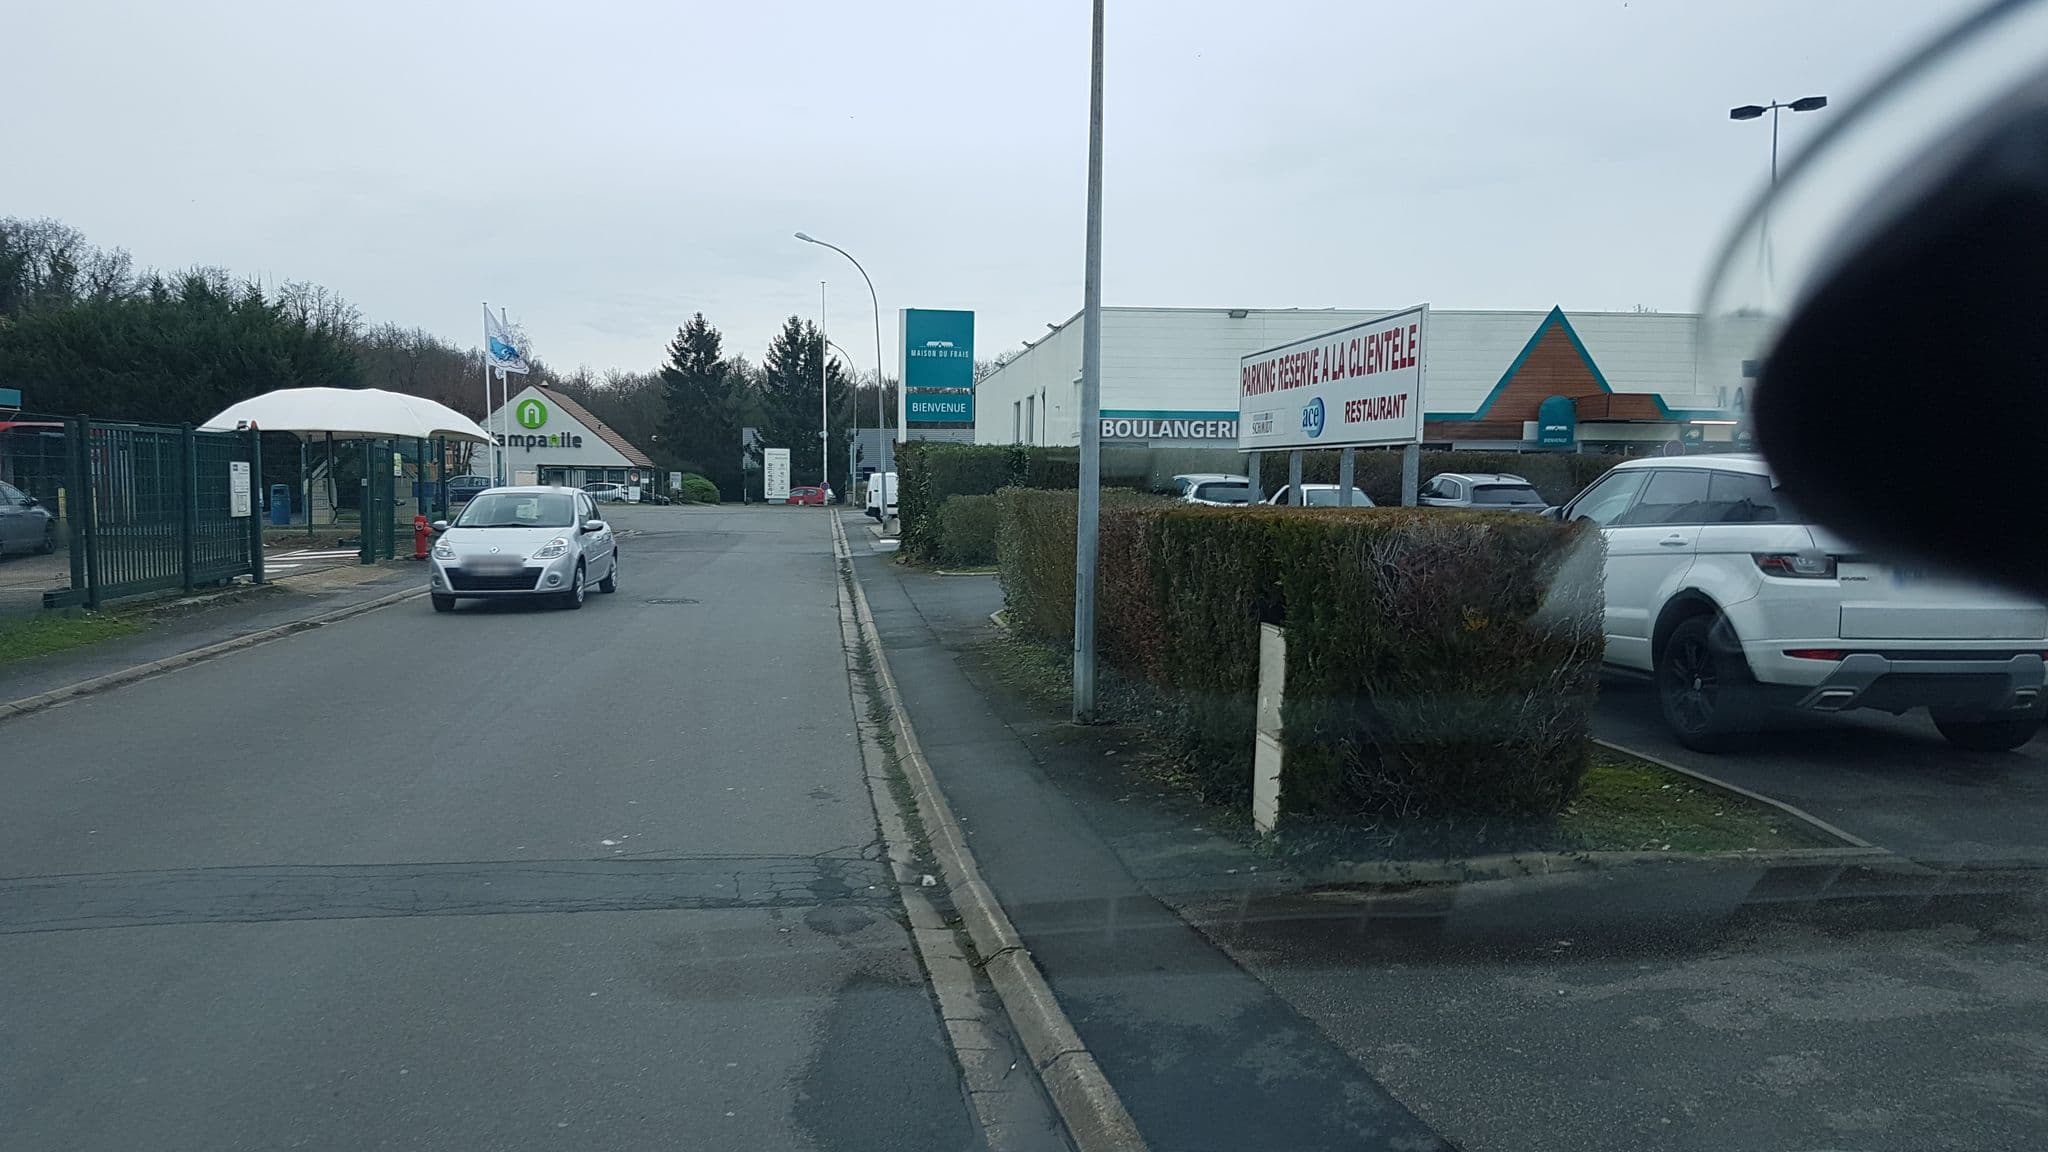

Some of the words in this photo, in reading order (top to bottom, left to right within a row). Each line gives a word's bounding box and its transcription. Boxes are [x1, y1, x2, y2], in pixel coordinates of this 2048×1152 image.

[911, 349, 937, 358] MAISON
[939, 349, 948, 358] DU
[950, 350, 969, 358] FRAIS
[1242, 358, 1276, 397] PARKING
[1321, 345, 1329, 383] A
[1331, 342, 1345, 381] LA
[912, 402, 966, 413] BIENVENUE
[1302, 407, 1319, 428] ace
[1344, 393, 1408, 424] RESTAURANT
